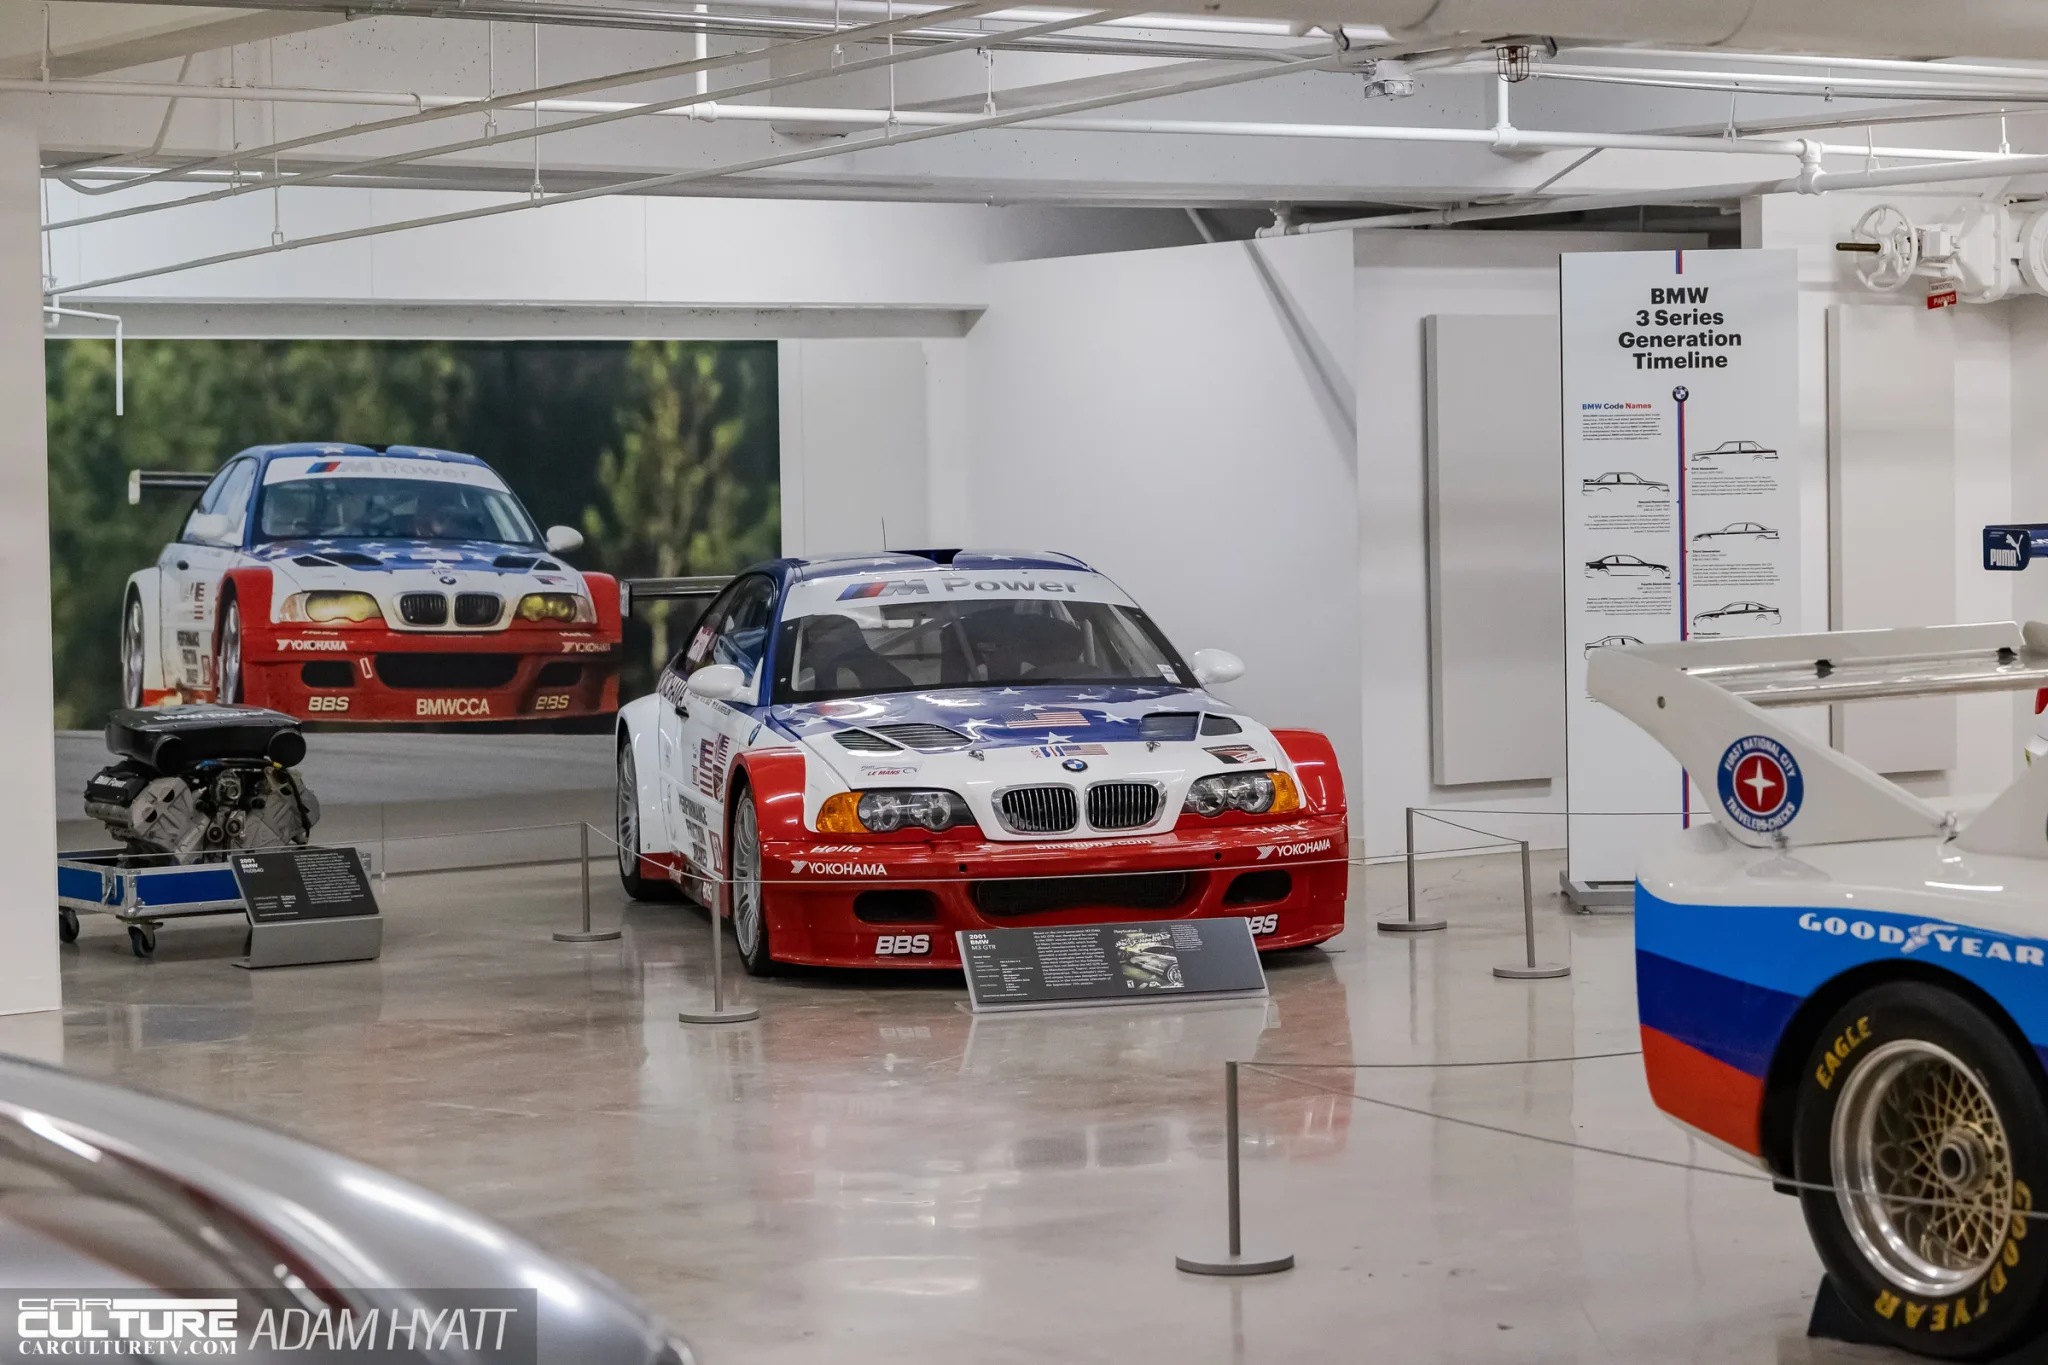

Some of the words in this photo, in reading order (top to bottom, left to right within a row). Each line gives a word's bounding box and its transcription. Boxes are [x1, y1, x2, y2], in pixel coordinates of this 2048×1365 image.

[1650, 287, 1709, 304] BMW
[1636, 310, 1650, 327] 3
[1655, 308, 1724, 327] Series
[1618, 330, 1742, 348] Generation
[1633, 351, 1728, 369] Timeline
[380, 460, 469, 478] Power
[1990, 548, 2017, 566] PUMA
[940, 577, 1080, 594] Power
[290, 640, 348, 651] YOKOHAMA
[308, 696, 350, 711] BBS
[416, 698, 490, 716] BMWCCA
[534, 694, 571, 711] BBS
[1724, 742, 1743, 772] FIRST
[1741, 737, 1781, 758] NATIONAL
[1780, 753, 1797, 777] CITY
[1768, 801, 1796, 830] CHECKS
[809, 844, 863, 853] Hella
[1034, 839, 1153, 850] bmwfilms.com
[1276, 838, 1331, 857] YOKOHAMA
[808, 862, 888, 875] YOKOHAMA
[1248, 913, 1278, 934] BS
[875, 934, 930, 955] BBS
[1815, 1015, 1873, 1090] EAGLE
